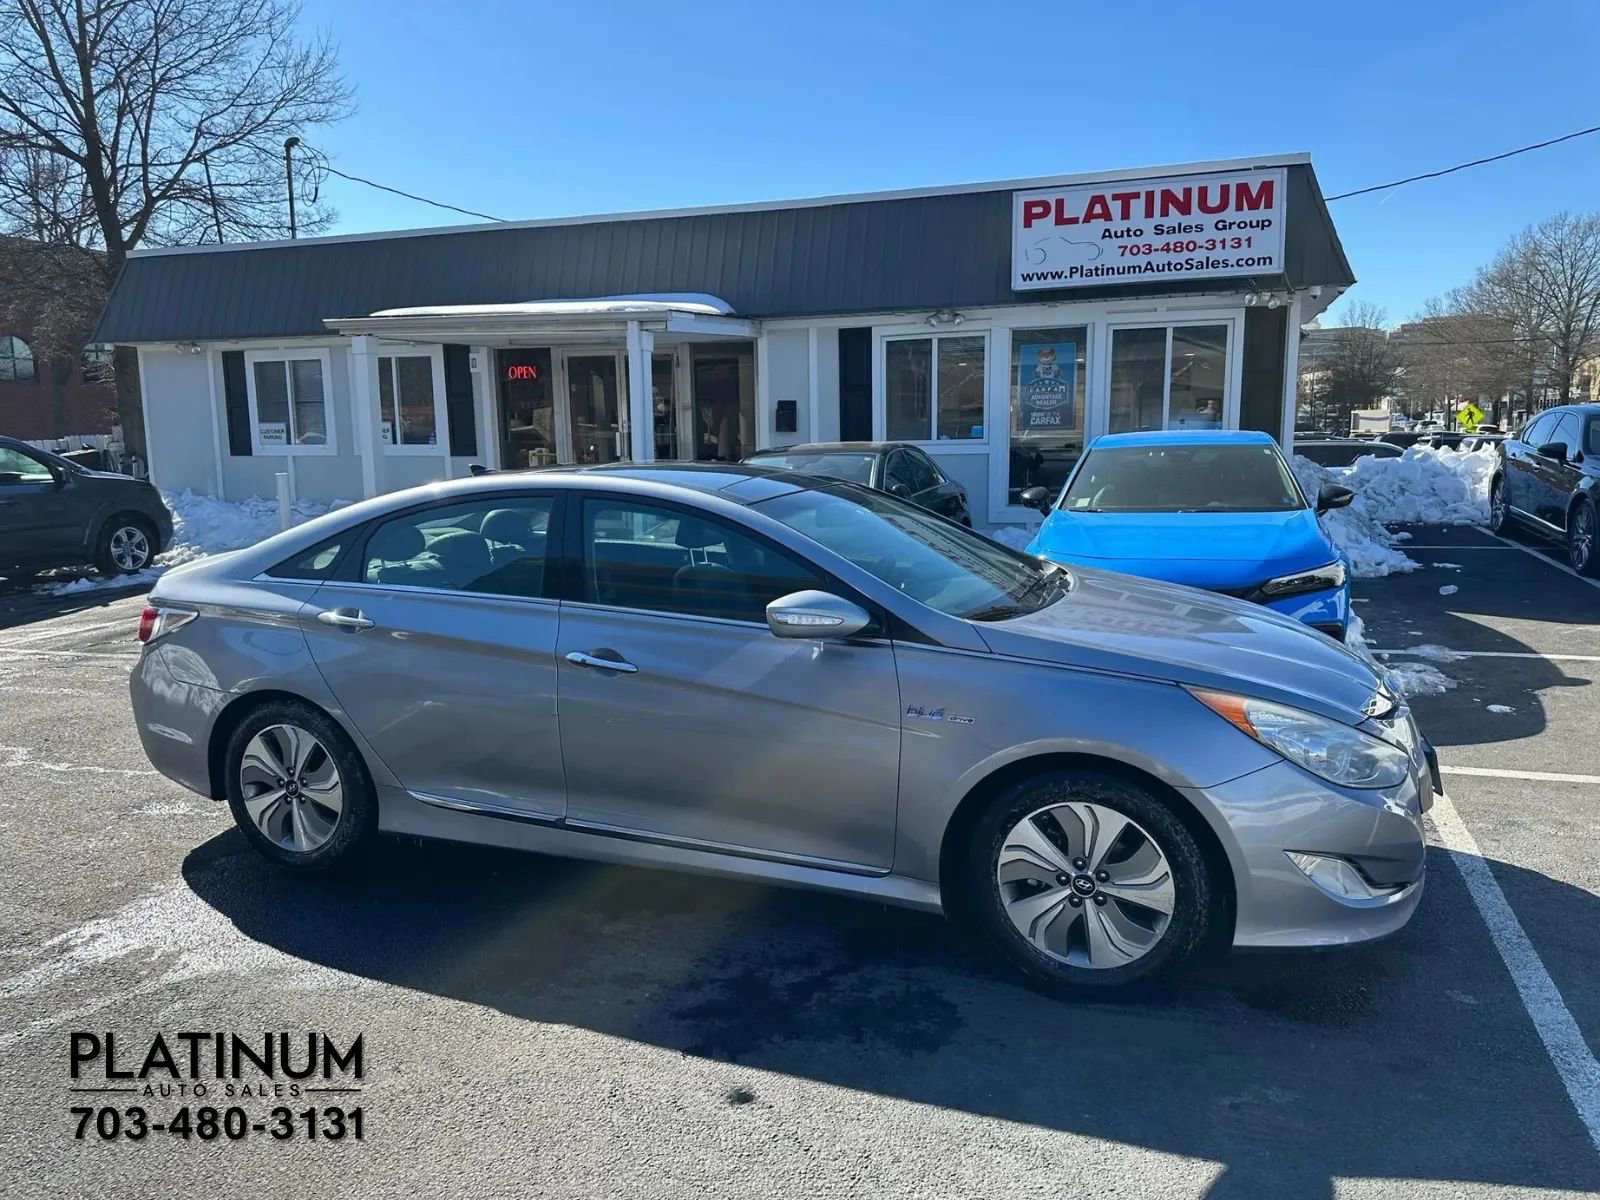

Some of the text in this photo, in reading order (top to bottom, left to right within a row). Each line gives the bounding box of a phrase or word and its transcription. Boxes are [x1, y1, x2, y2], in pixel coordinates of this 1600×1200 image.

[1023, 180, 1275, 228] PLATINUM
[1101, 218, 1272, 240] Auto Sales Group
[1118, 236, 1253, 257] 703-480-3131
[1021, 254, 1273, 282] www.PlatinumAutoSales.com
[508, 366, 537, 379] OPEN
[1030, 417, 1061, 425] CARFAX
